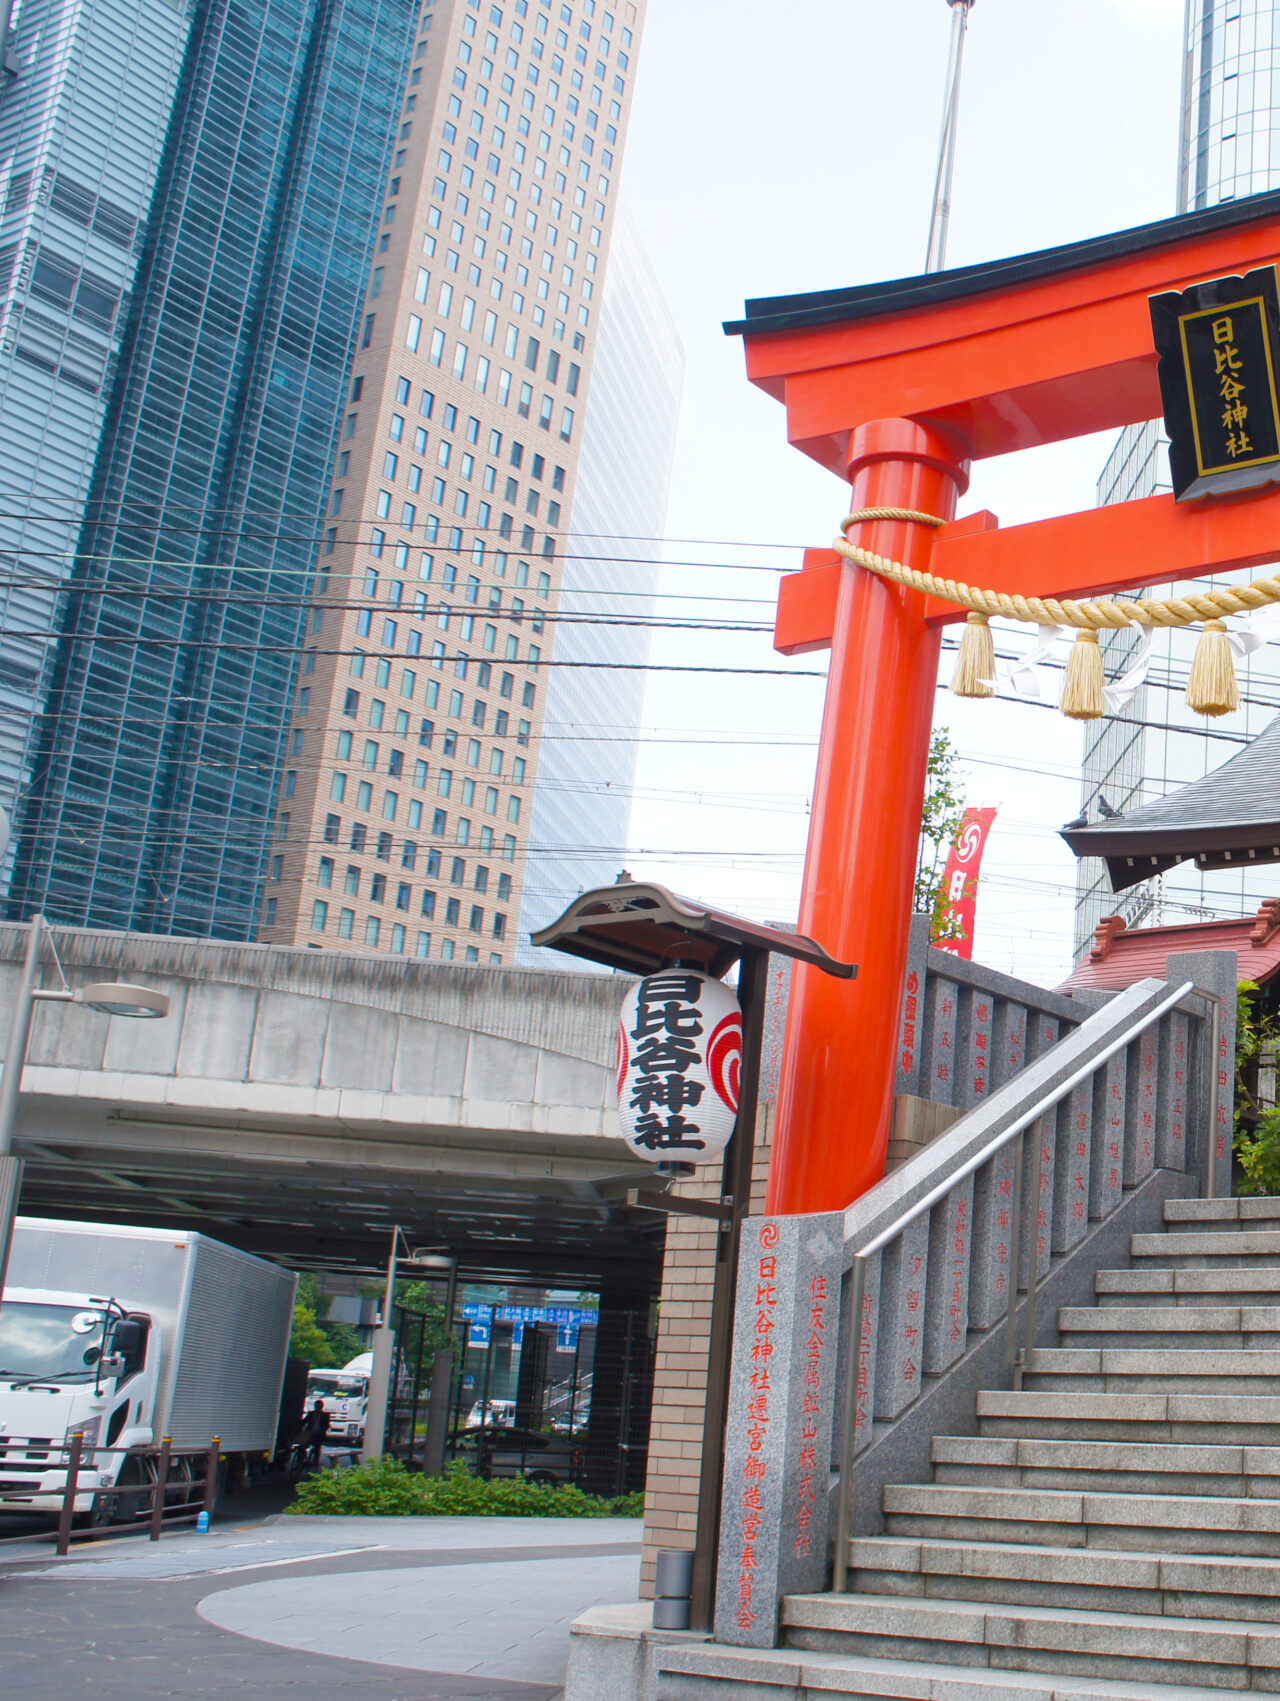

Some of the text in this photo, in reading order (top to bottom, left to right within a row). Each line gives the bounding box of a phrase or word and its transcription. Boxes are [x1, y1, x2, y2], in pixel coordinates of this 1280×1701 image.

[1211, 315, 1254, 458] 日比谷神社
[942, 869, 967, 957] 日比
[629, 975, 706, 1150] 日比谷神社
[795, 1274, 828, 1559] 住友金属鉱山株式会社
